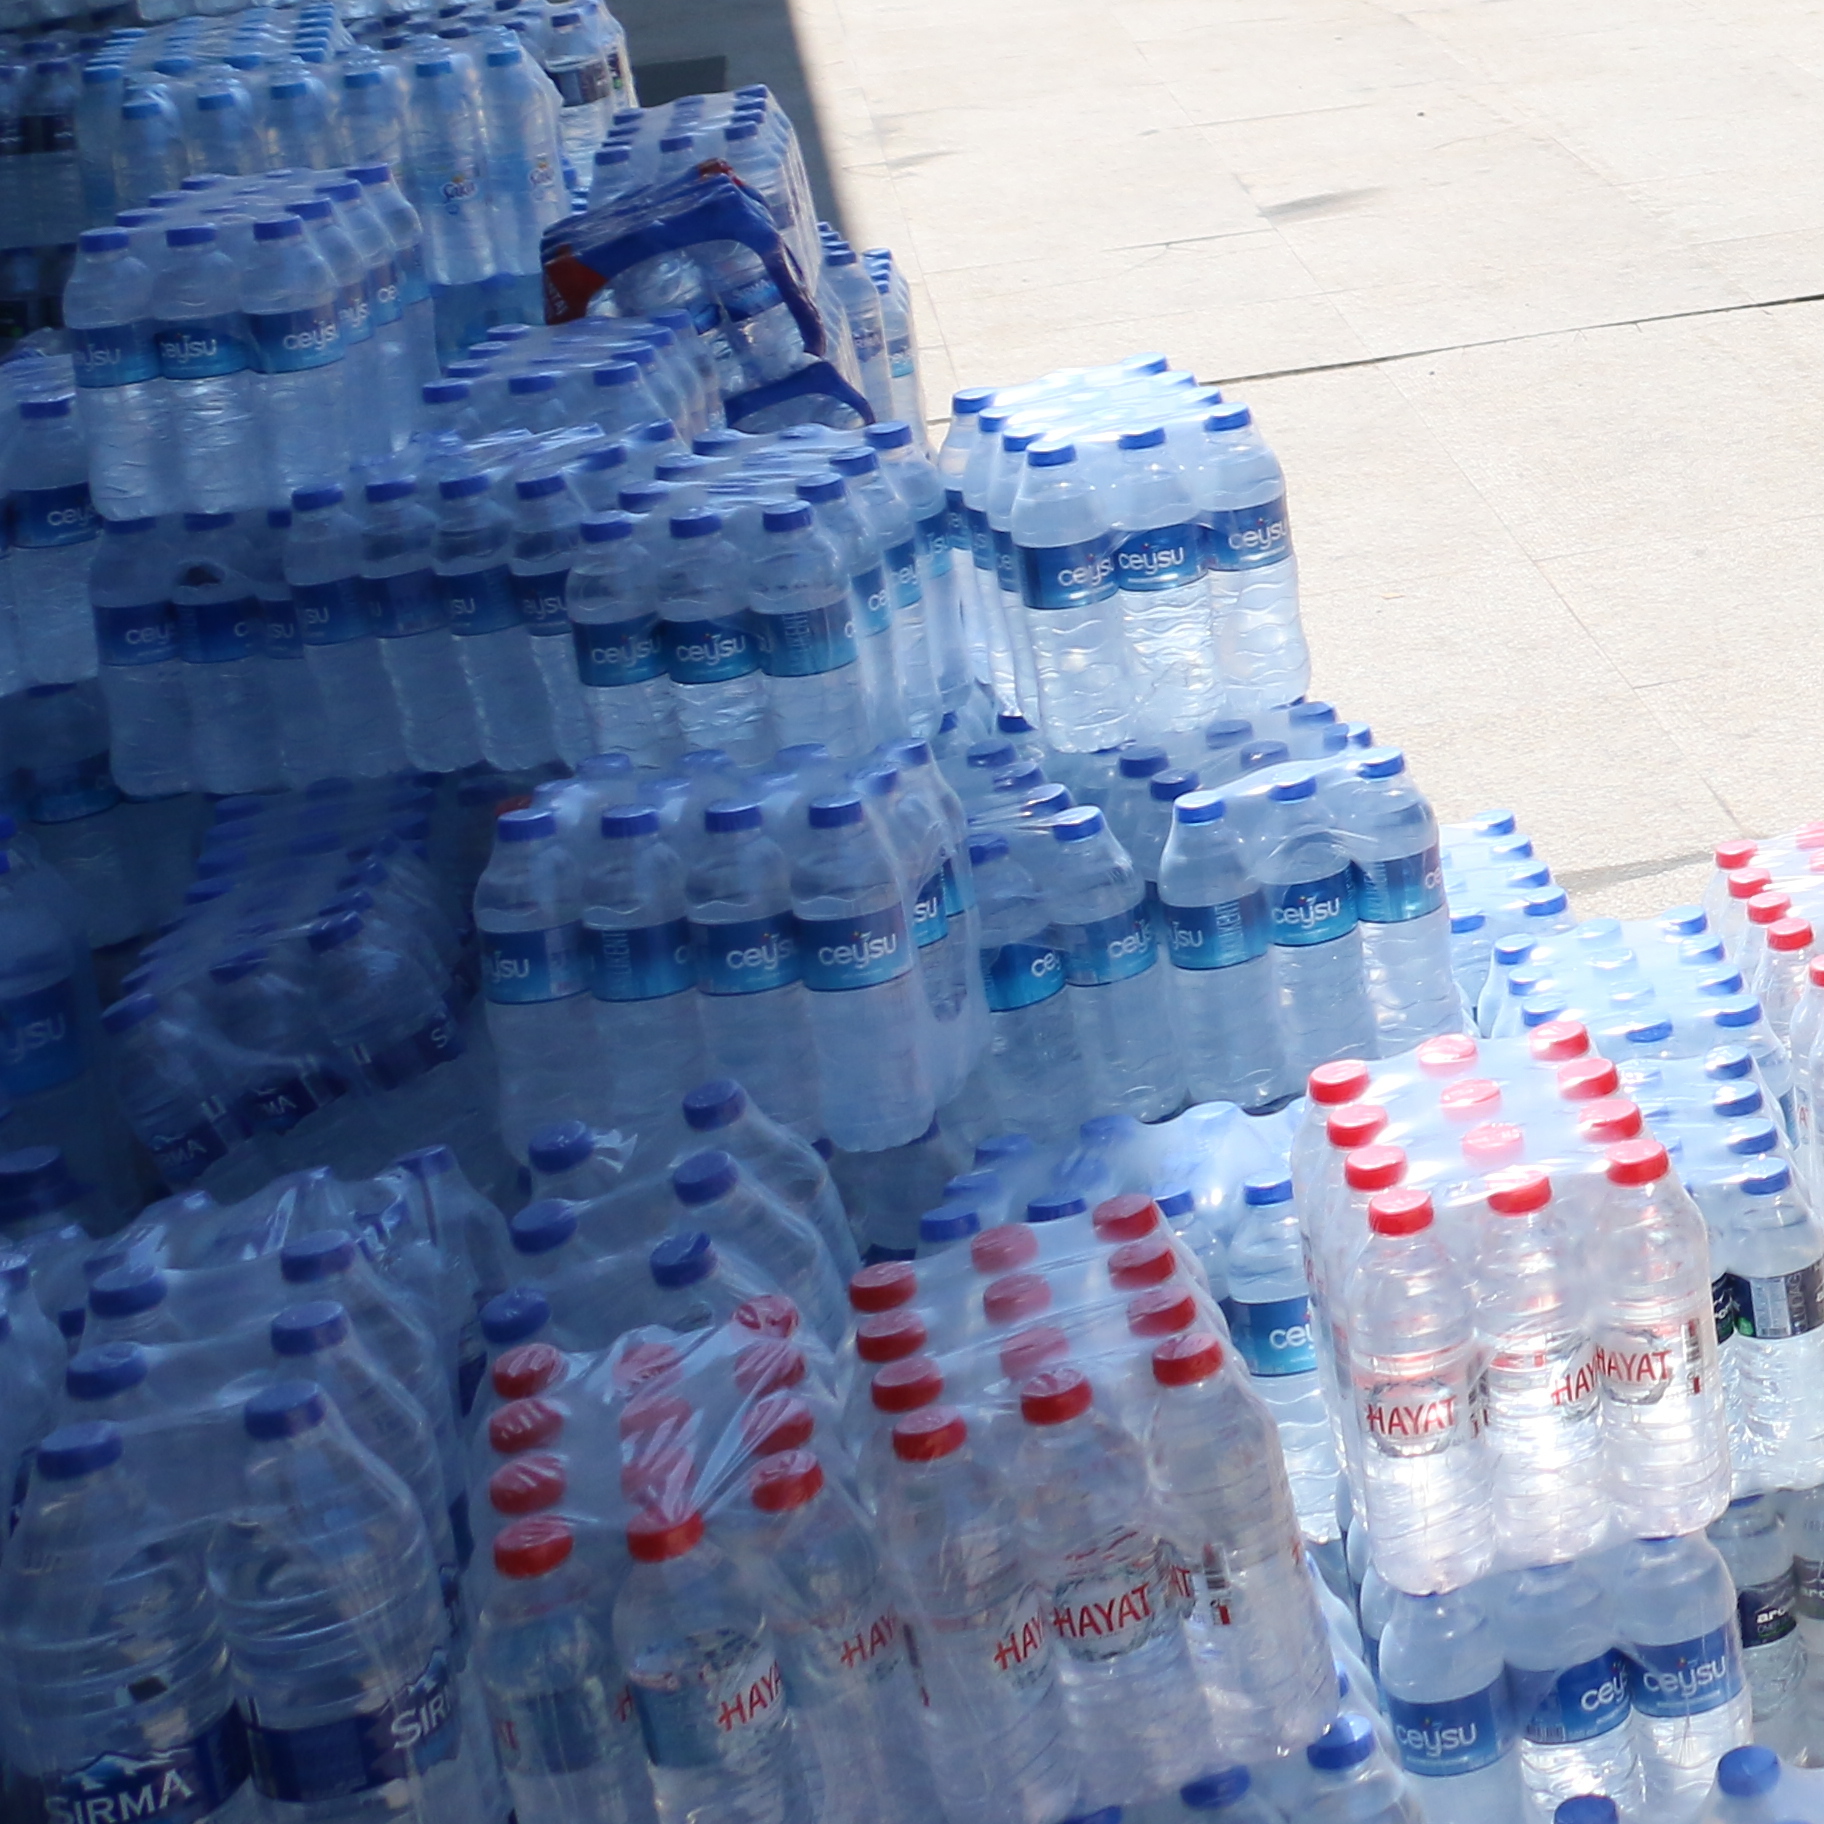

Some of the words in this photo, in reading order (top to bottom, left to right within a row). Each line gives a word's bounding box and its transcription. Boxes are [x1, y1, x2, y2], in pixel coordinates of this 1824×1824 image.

[1118, 546, 1184, 577] ceysu
[675, 630, 746, 666] ceysu
[1273, 895, 1341, 931] ceysu
[818, 927, 898, 980] ceysu
[1551, 1361, 1600, 1408] HAY
[1367, 1394, 1456, 1437] HAYAT
[1053, 1581, 1150, 1639] HAYAT
[841, 1606, 898, 1668] HAY
[993, 1608, 1044, 1670] HAY
[1643, 1655, 1726, 1696] ceysu
[1398, 1720, 1478, 1757] ceysu
[44, 1768, 194, 1824] SIRMA
